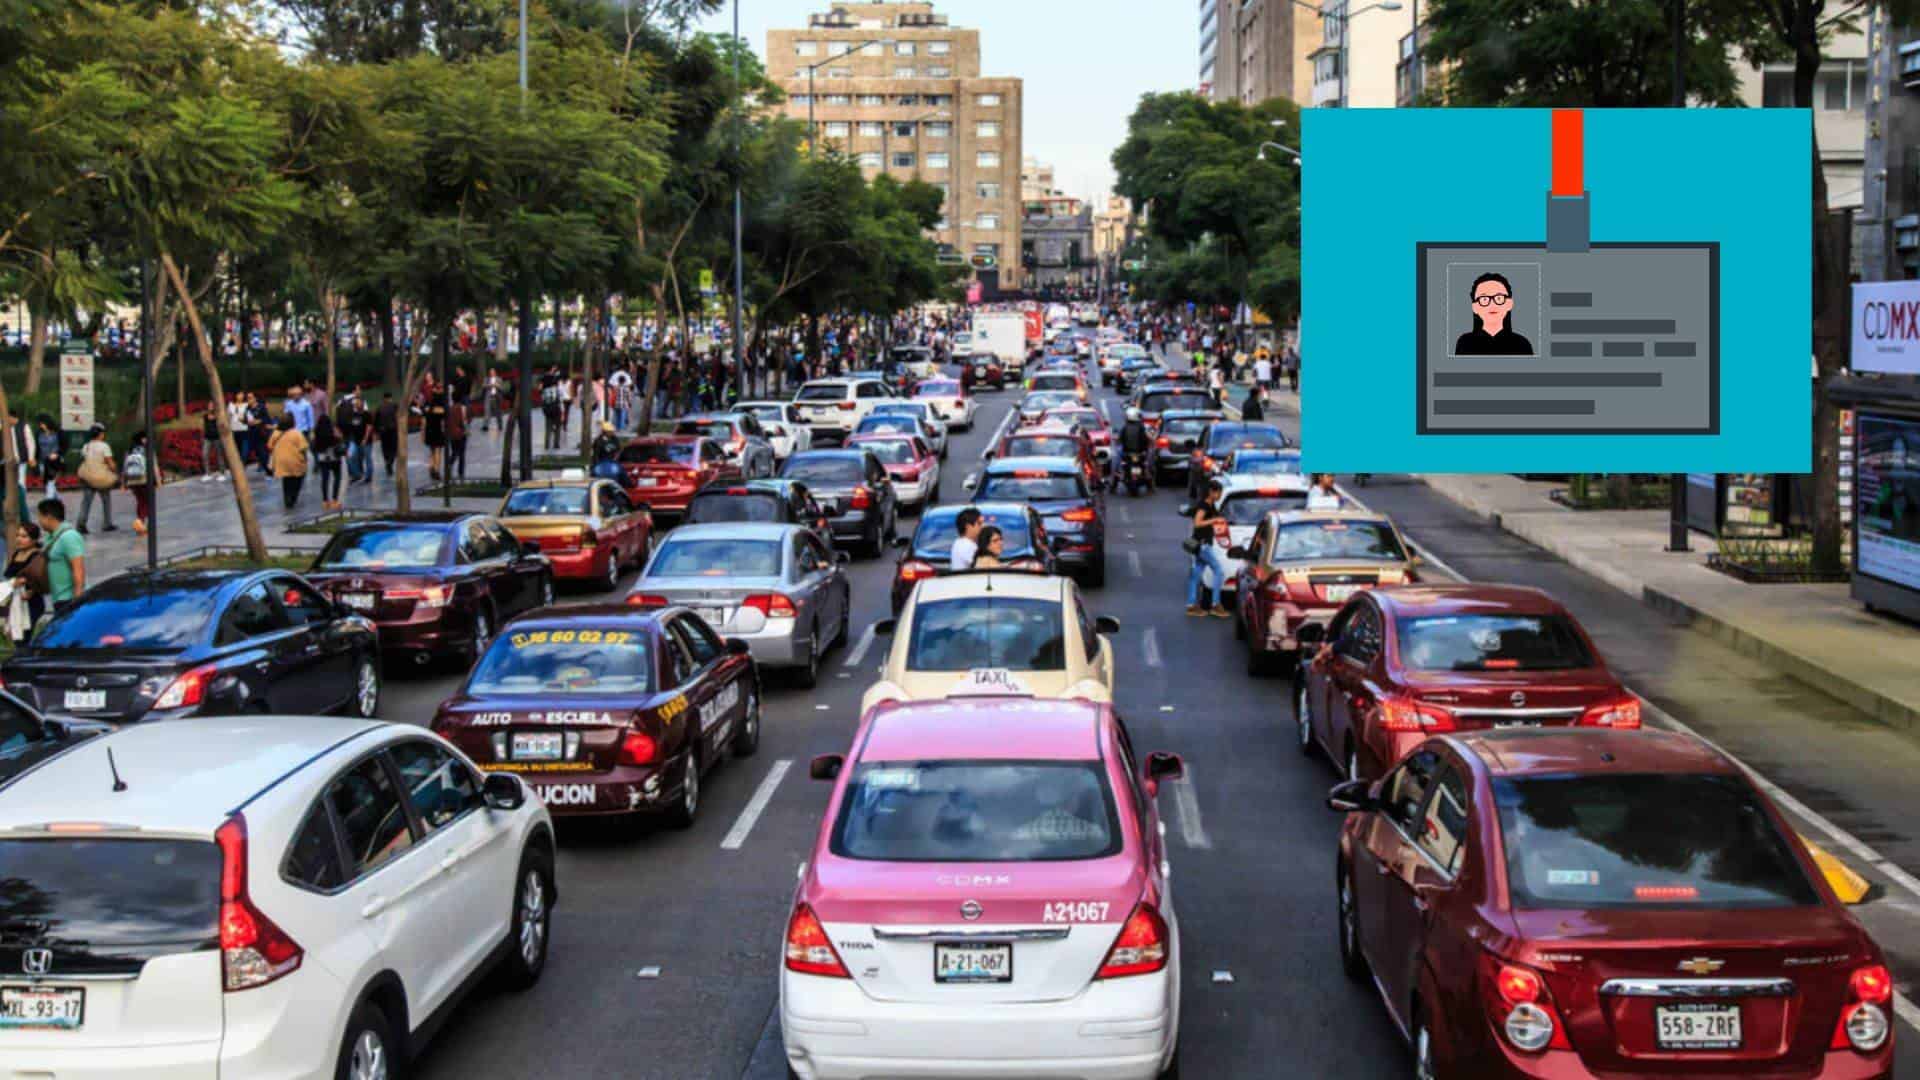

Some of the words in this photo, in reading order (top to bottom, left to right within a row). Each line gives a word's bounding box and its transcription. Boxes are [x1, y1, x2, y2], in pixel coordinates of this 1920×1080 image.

[1864, 301, 1920, 339] CDMX
[578, 631, 602, 644] 02
[974, 671, 1007, 684] TAXI
[472, 712, 512, 725] AUTO
[545, 712, 612, 724] ESCUELA
[936, 874, 1009, 886] CDMX
[942, 953, 1004, 970] A-21-067
[1662, 1016, 1736, 1036] 558-ZRF
